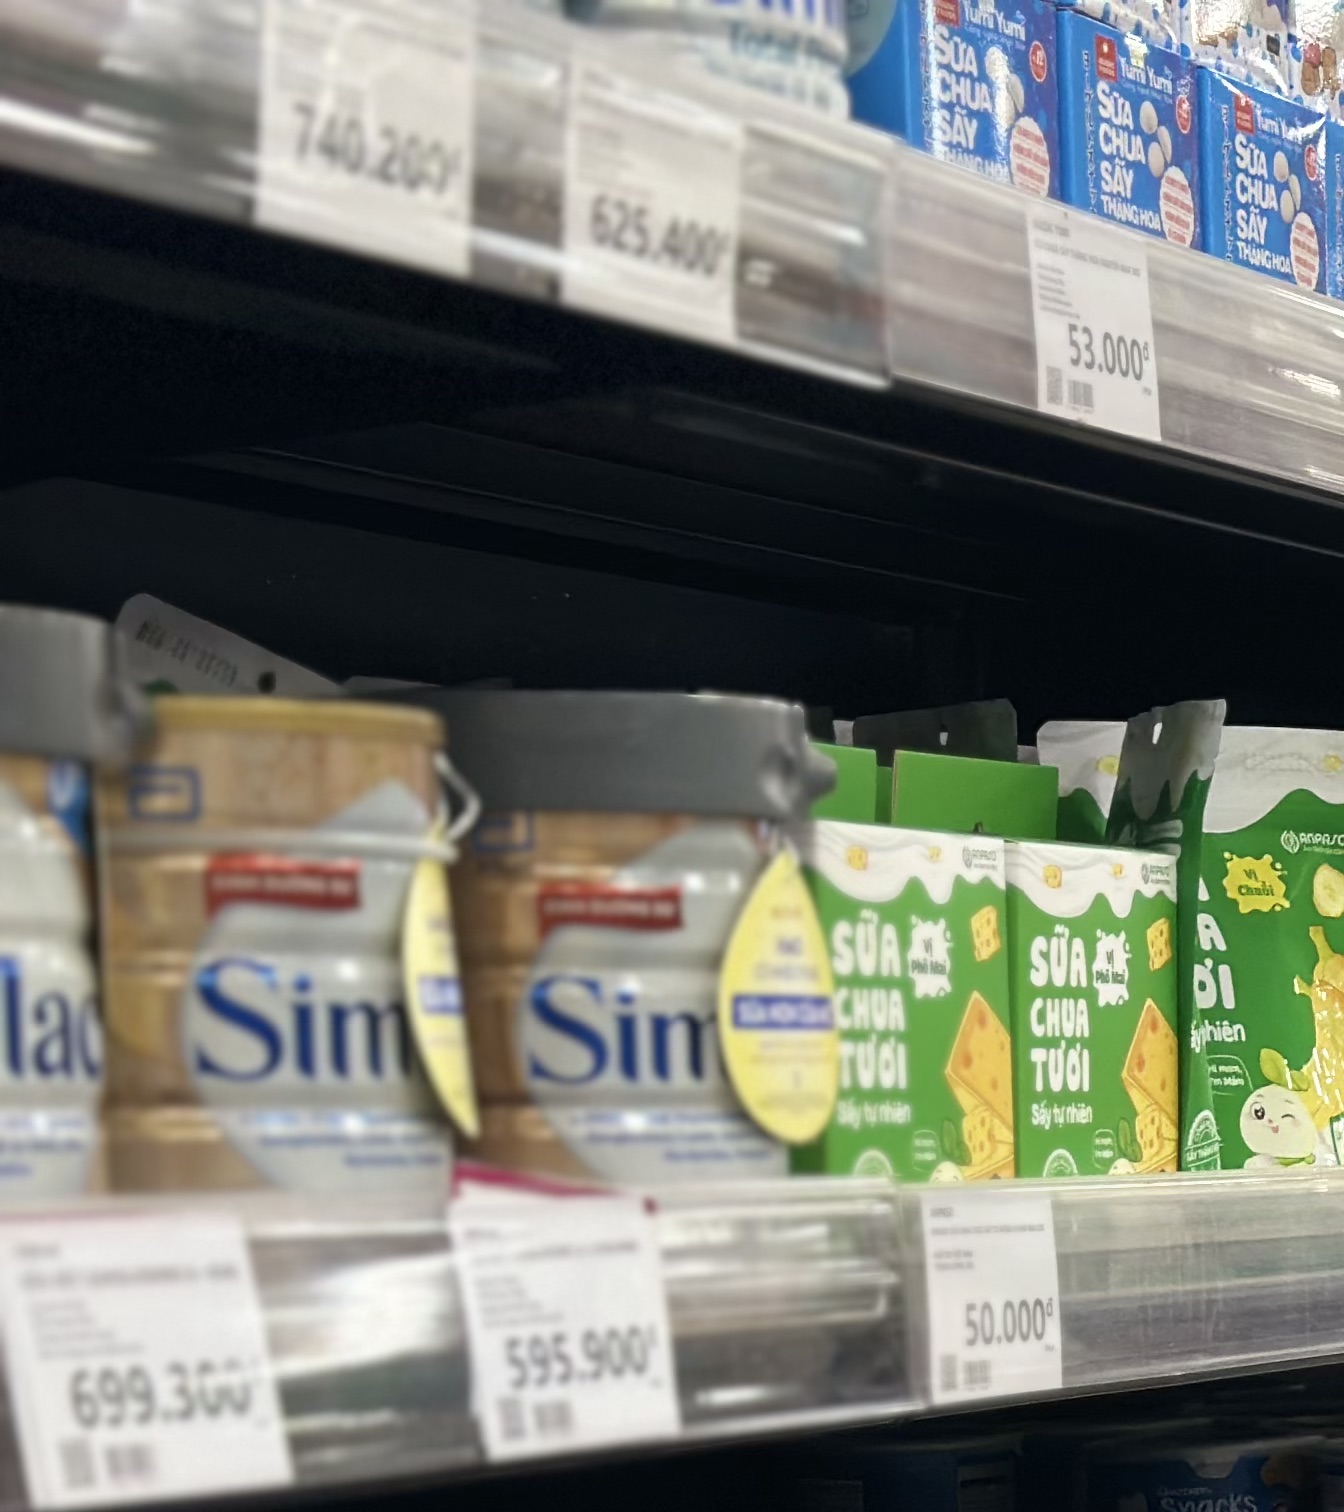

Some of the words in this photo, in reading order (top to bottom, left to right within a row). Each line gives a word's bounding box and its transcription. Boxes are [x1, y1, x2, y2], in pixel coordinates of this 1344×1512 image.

[934, 24, 978, 77] SỮA
[935, 68, 993, 113] CHUA
[1097, 82, 1133, 128] SỮA
[1148, 72, 1173, 95] Yumi
[1099, 124, 1146, 164] CHUA
[1235, 133, 1268, 178] SỮA
[1236, 174, 1279, 212] CHUA
[1139, 211, 1161, 231] HOA
[1272, 256, 1292, 274] HOA
[1068, 323, 1150, 381] 53.000đ
[832, 908, 901, 976] SỮA
[1030, 924, 1087, 988] SỮA
[194, 956, 413, 1082] Sim
[526, 973, 718, 1085] Sim
[837, 987, 906, 1032] CHUA
[1030, 998, 1090, 1038] CHUA
[839, 1037, 908, 1089] TƯƠI
[1030, 1040, 1090, 1093] TƯƠI
[875, 1101, 911, 1124] nhiên
[1031, 1103, 1050, 1129] Sấy
[1063, 1103, 1092, 1124] nhiên
[965, 1298, 1053, 1347] 50.000đ
[71, 1360, 253, 1429] 699.300
